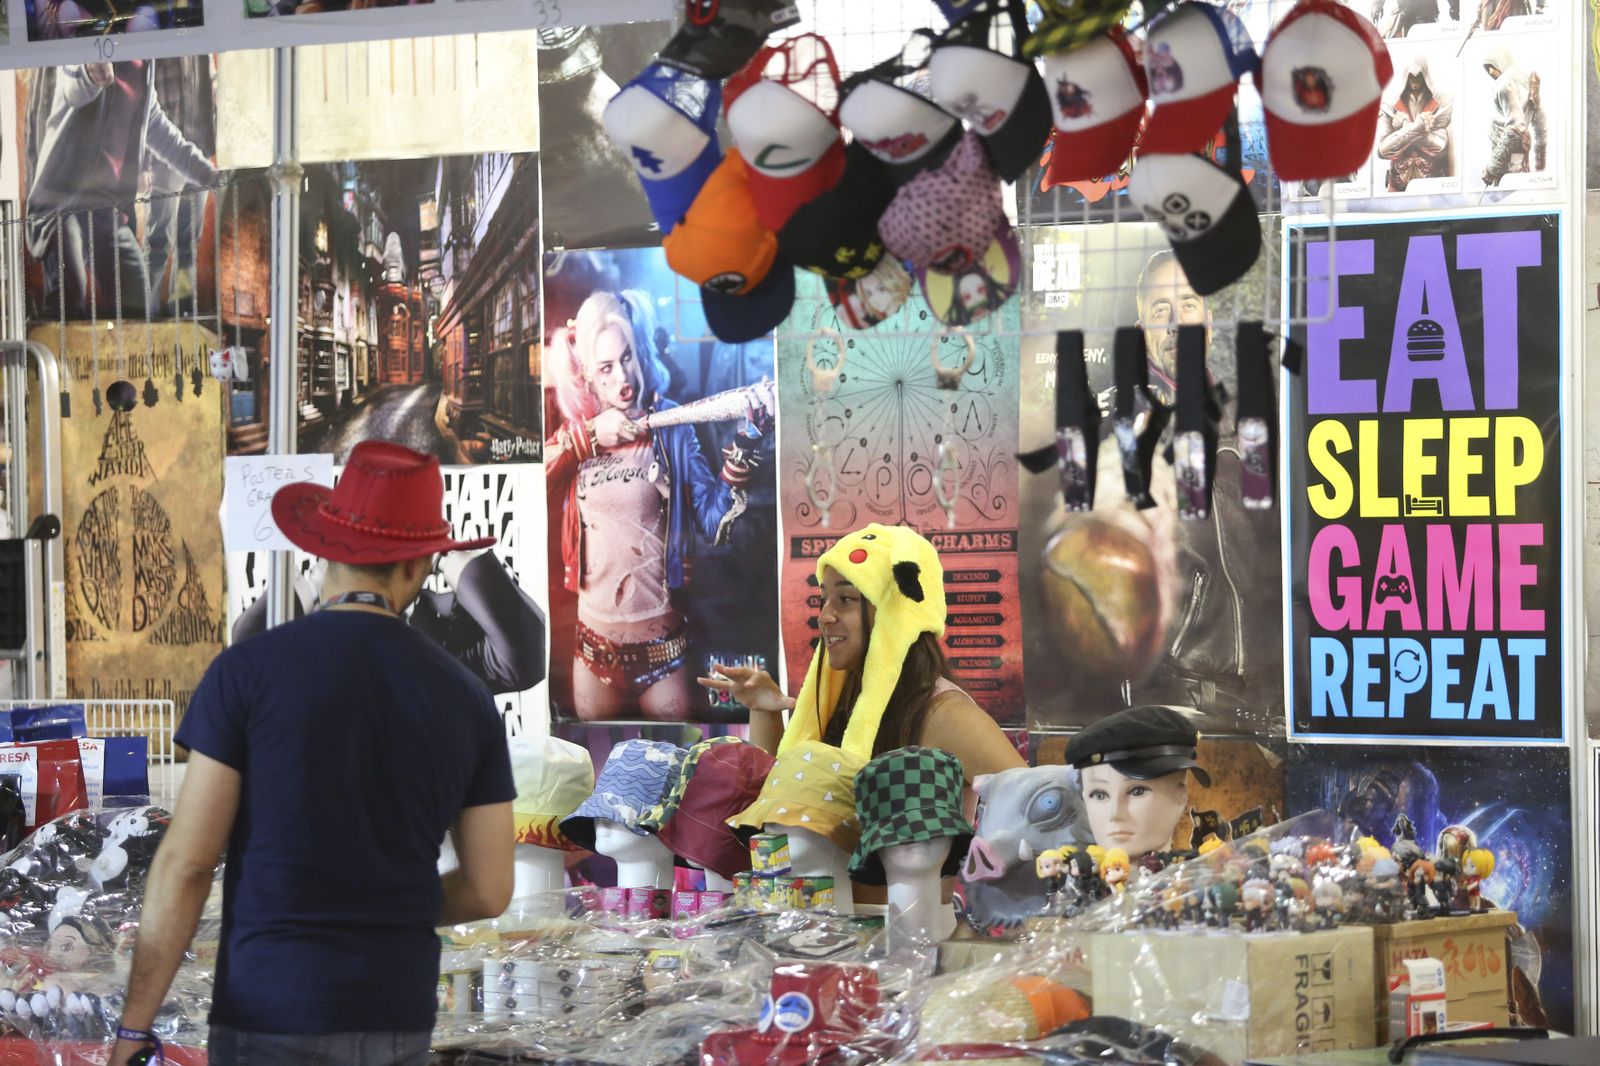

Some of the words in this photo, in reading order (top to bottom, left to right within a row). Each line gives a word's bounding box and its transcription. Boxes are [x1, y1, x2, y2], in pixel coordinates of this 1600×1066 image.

[94, 38, 114, 59] 10
[1306, 230, 1542, 415] EAT
[1307, 416, 1544, 519] SLEEP
[930, 533, 1013, 551] CHARMS
[952, 572, 990, 581] DESCENDO
[1307, 523, 1545, 631] GAME
[1309, 636, 1547, 720] REPEAT
